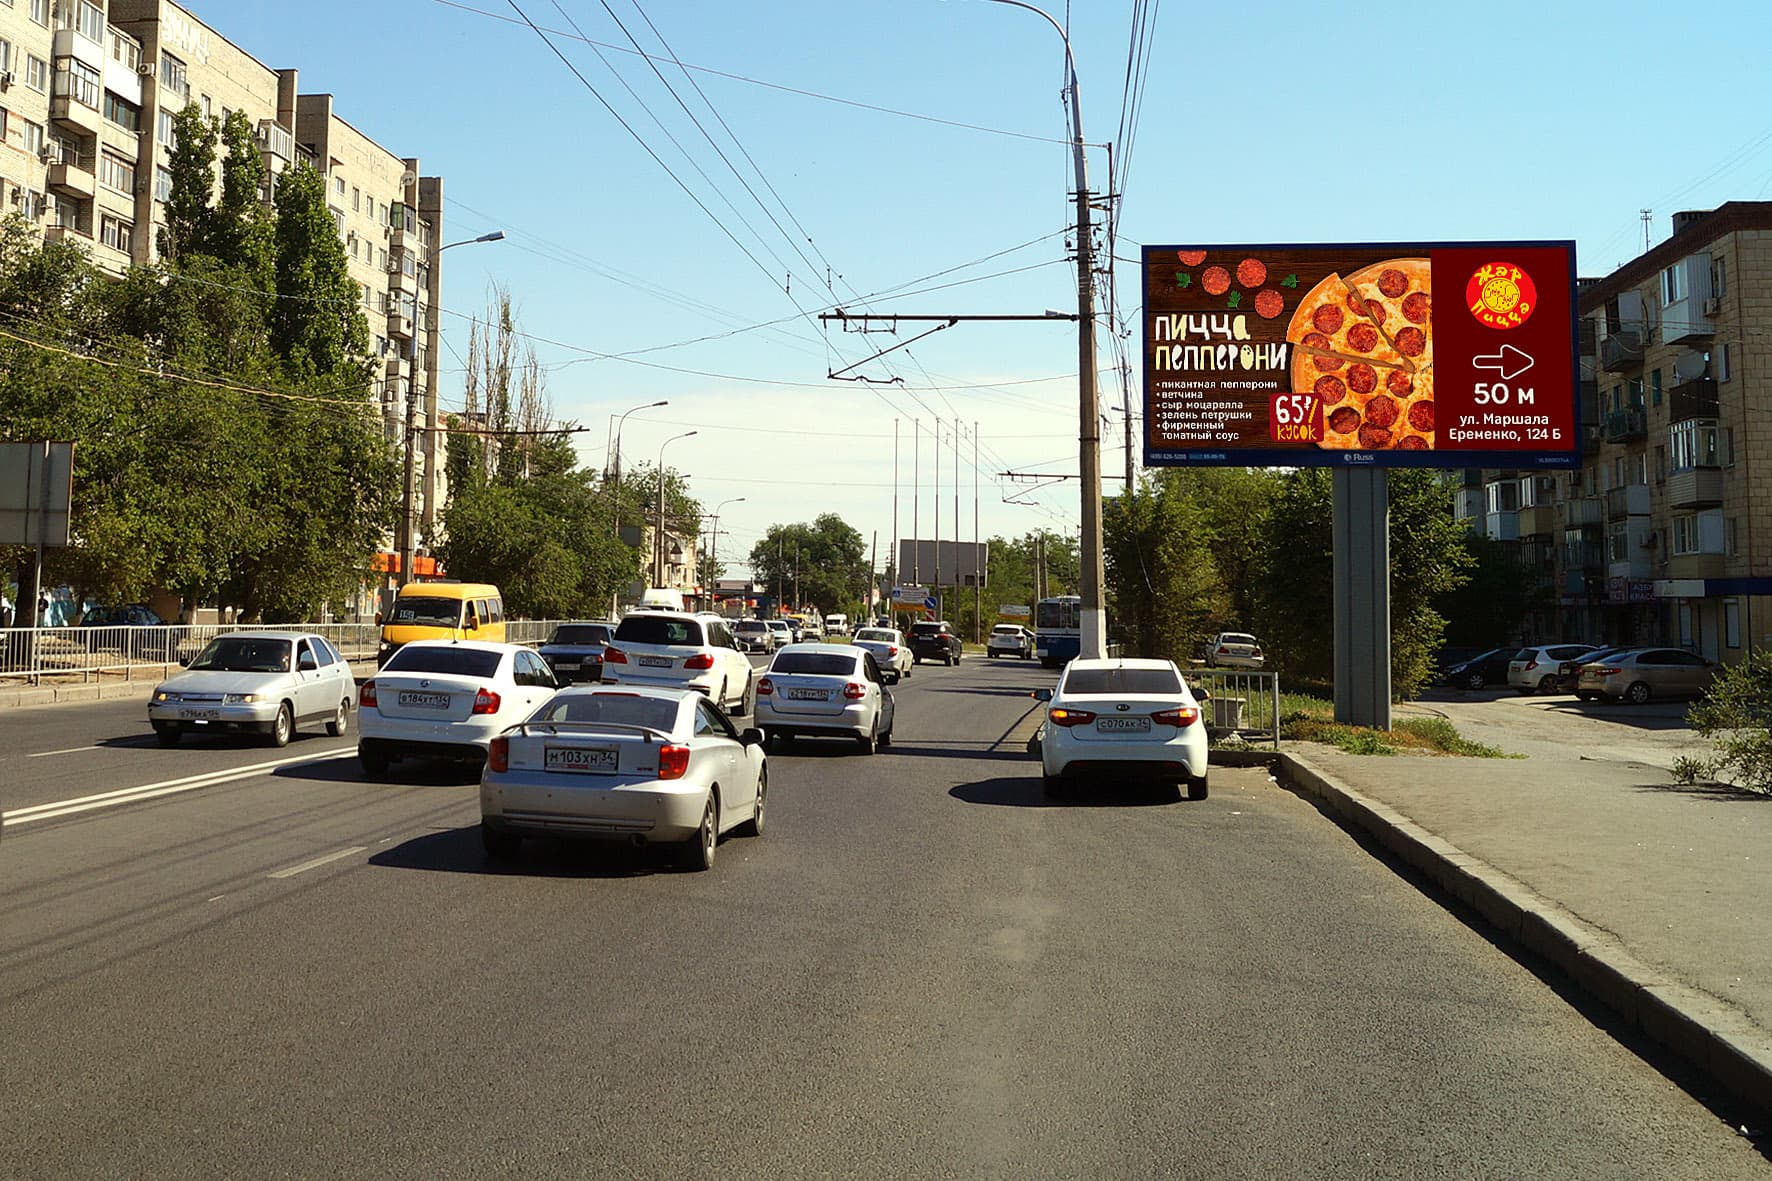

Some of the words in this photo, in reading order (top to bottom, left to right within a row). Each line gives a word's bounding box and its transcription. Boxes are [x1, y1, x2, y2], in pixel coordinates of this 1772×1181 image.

[1161, 381, 1216, 389] пикантная
[1220, 381, 1278, 391] пепперони
[1161, 391, 1203, 399] ветчина
[1474, 382, 1510, 405] 50
[1518, 387, 1535, 405] м
[1161, 401, 1183, 410] сыр
[1186, 401, 1244, 410] моцарелла
[1161, 411, 1199, 420] зелень
[1201, 411, 1252, 422] петрушки
[1459, 415, 1480, 427] ул.
[1483, 413, 1549, 427] Маршала
[1161, 421, 1225, 431] фирменный
[1161, 430, 1212, 440] томатный
[1215, 432, 1240, 441] соус
[1449, 428, 1521, 442] Еременко,
[1525, 428, 1549, 440] 124
[1552, 428, 1562, 440] Б
[550, 751, 598, 764] М103ХН
